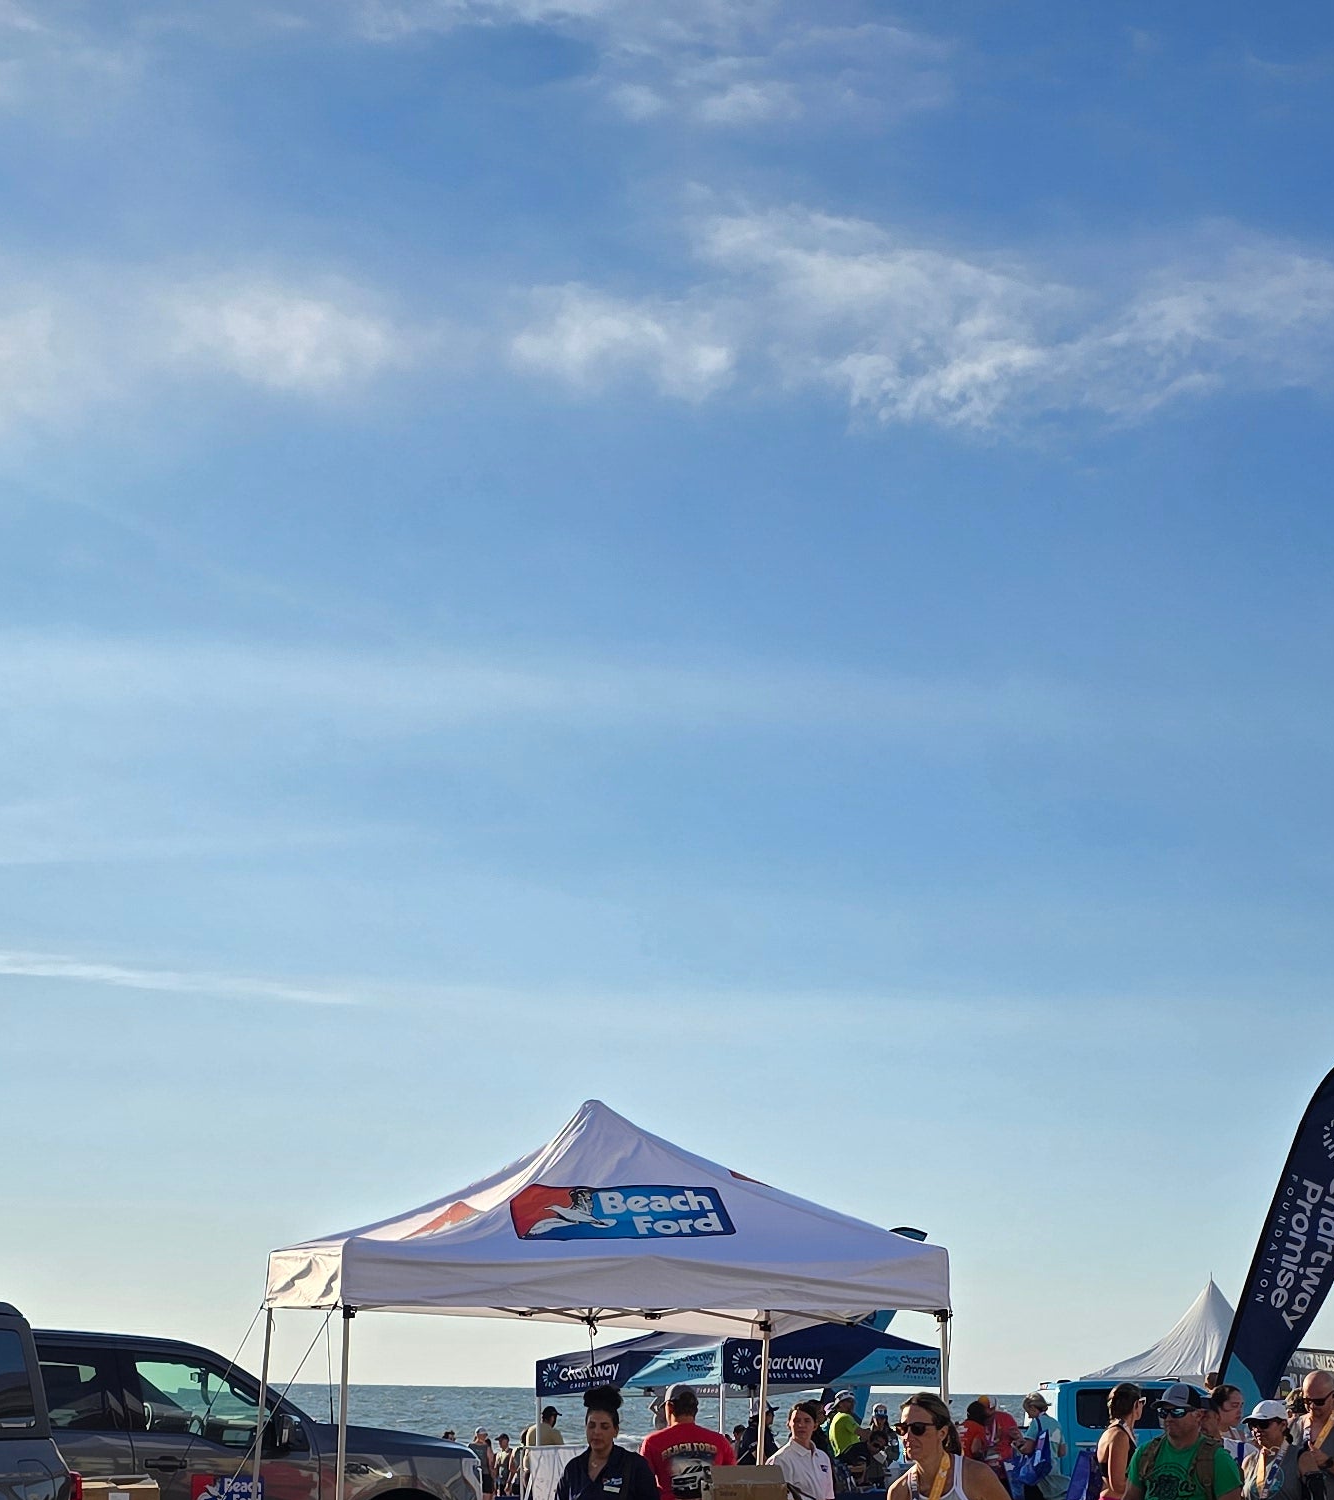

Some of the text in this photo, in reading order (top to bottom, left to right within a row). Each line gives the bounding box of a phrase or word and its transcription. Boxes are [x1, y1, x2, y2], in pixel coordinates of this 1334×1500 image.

[598, 1190, 714, 1215] Beach
[632, 1212, 724, 1235] Ford
[1255, 1174, 1299, 1303] FOUNDATION
[1270, 1178, 1324, 1309] Promise
[558, 1362, 620, 1382] Chartway
